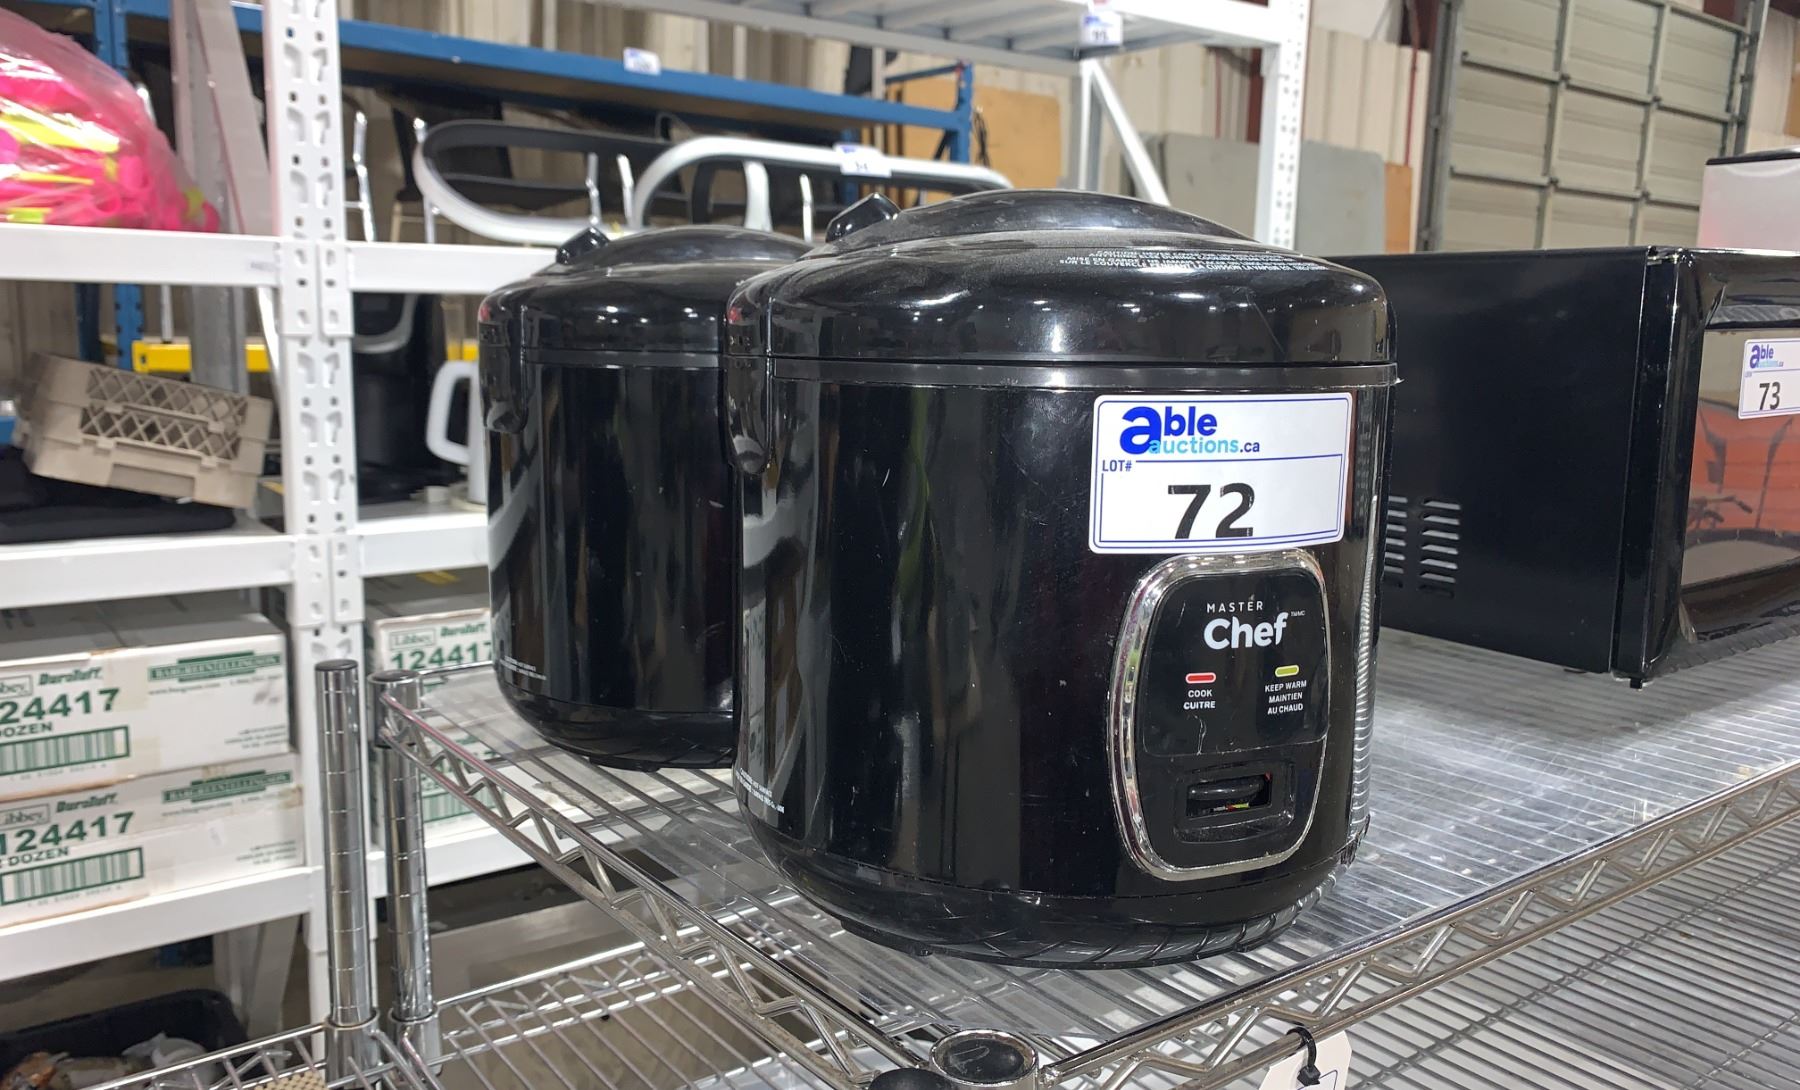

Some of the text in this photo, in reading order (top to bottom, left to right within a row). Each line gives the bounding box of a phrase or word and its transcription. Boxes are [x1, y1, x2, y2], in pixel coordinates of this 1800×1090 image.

[1749, 344, 1774, 369] able
[1759, 381, 1781, 411] 73
[1119, 406, 1218, 455] able
[1149, 436, 1261, 454] auctions.ca
[1102, 459, 1132, 472] LOT#
[1168, 483, 1255, 540] 72
[1206, 601, 1264, 613] MASTER
[1203, 611, 1289, 650] Chef
[1188, 689, 1213, 698] COOK
[1264, 680, 1307, 692] KEEP WARM
[1183, 701, 1216, 710] CUITRE
[1268, 692, 1303, 703] MAINTIEN
[1267, 703, 1304, 715] AU CHAUD
[0, 721, 53, 738] OZEN
[8, 845, 70, 867] DOZEN
